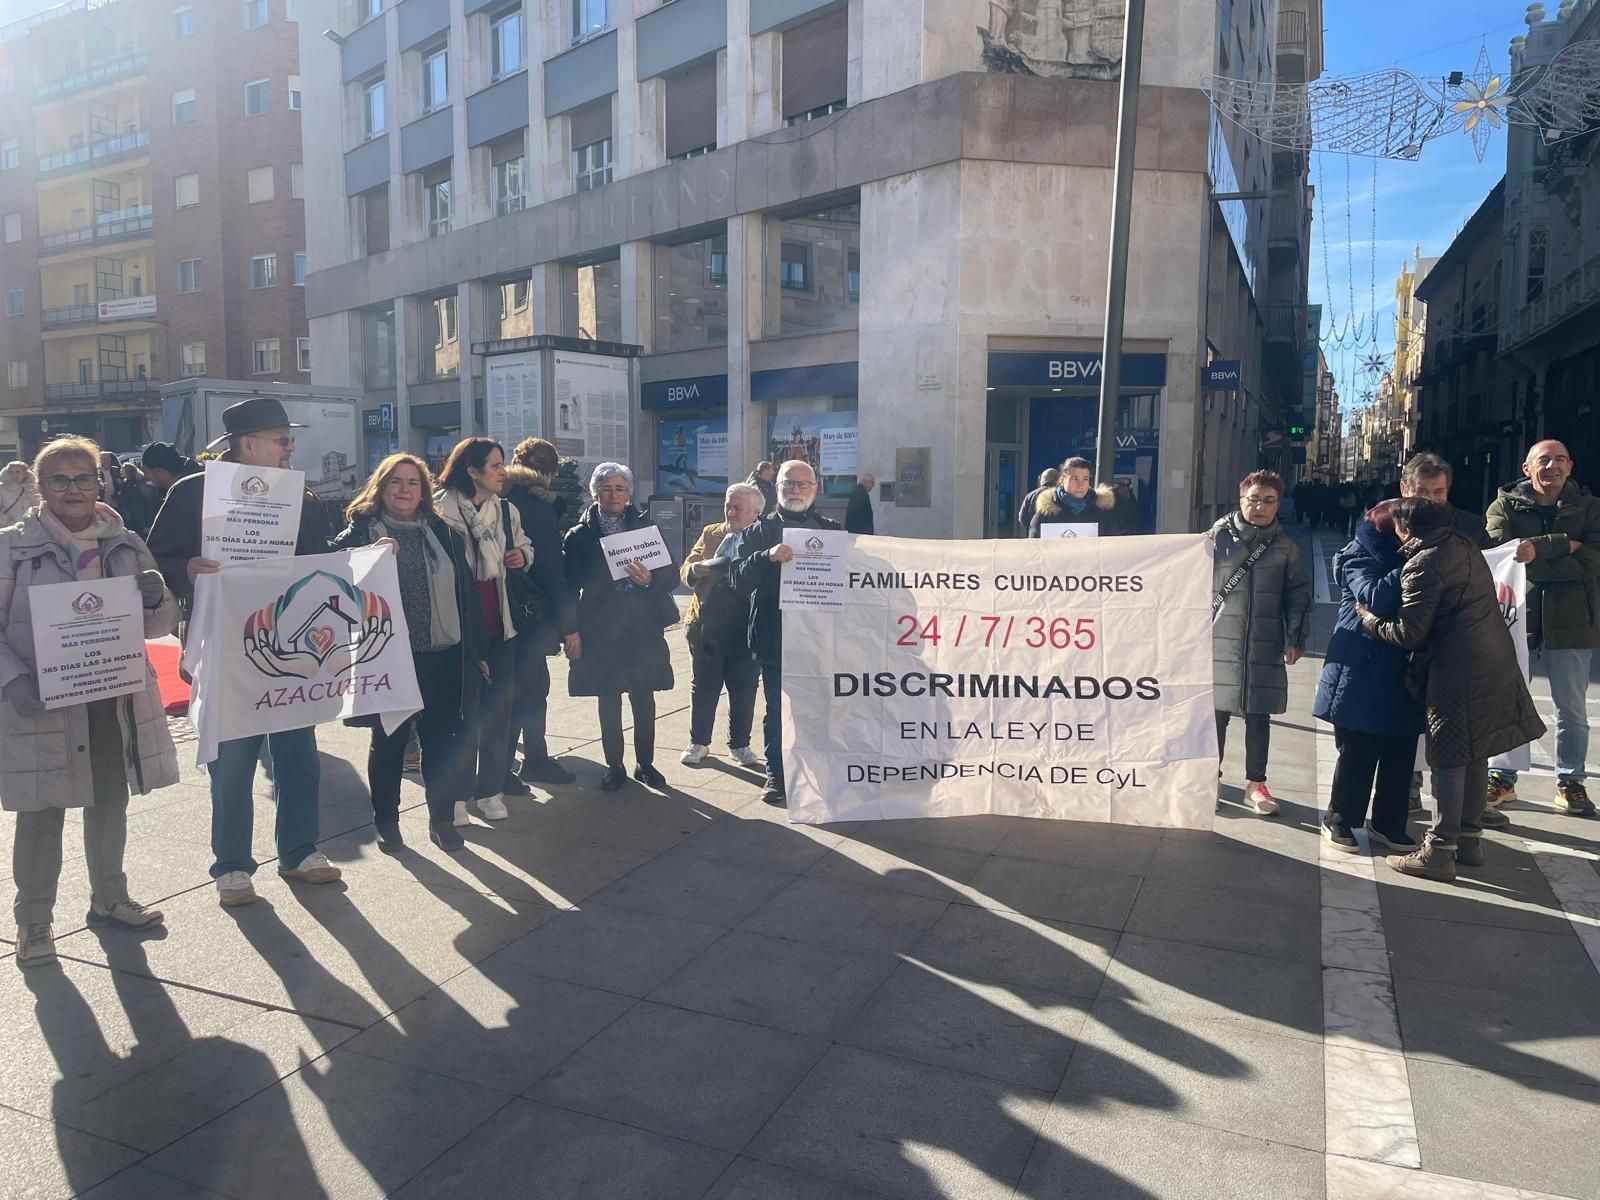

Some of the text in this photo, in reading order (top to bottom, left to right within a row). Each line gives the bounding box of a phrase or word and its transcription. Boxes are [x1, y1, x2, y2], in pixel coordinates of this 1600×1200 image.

[1049, 360, 1103, 378] BBVA
[1212, 372, 1237, 380] BBVA
[669, 384, 700, 401] BBVA
[369, 416, 380, 426] BBV
[901, 472, 924, 482] BBVA
[244, 518, 279, 526] PERSONAS
[222, 536, 240, 544] DÍAS
[608, 540, 660, 558] Menos trabas,
[1246, 543, 1266, 567] BIMBAY
[616, 550, 661, 567] más ayudas
[849, 572, 1144, 592] FAMILIARES CUIDADORES
[1224, 567, 1246, 594] BIMBAY
[81, 635, 120, 646] PERSONAS
[897, 615, 942, 647] 24
[1025, 616, 1096, 650] 365
[61, 662, 81, 671] DÍAS
[83, 660, 100, 668] LAS
[114, 652, 143, 662] HORAS
[85, 650, 102, 658] LOS
[95, 666, 127, 675] CUIDANDO
[73, 679, 102, 688] PORQUE
[255, 673, 392, 711] AZACUEFA
[834, 672, 1161, 701] DISCRIMINADOS
[45, 691, 84, 702] NUESTROS
[900, 722, 1095, 741] EN LA LEY DE
[848, 761, 1146, 789] DEPENDENCIA DE CyL
